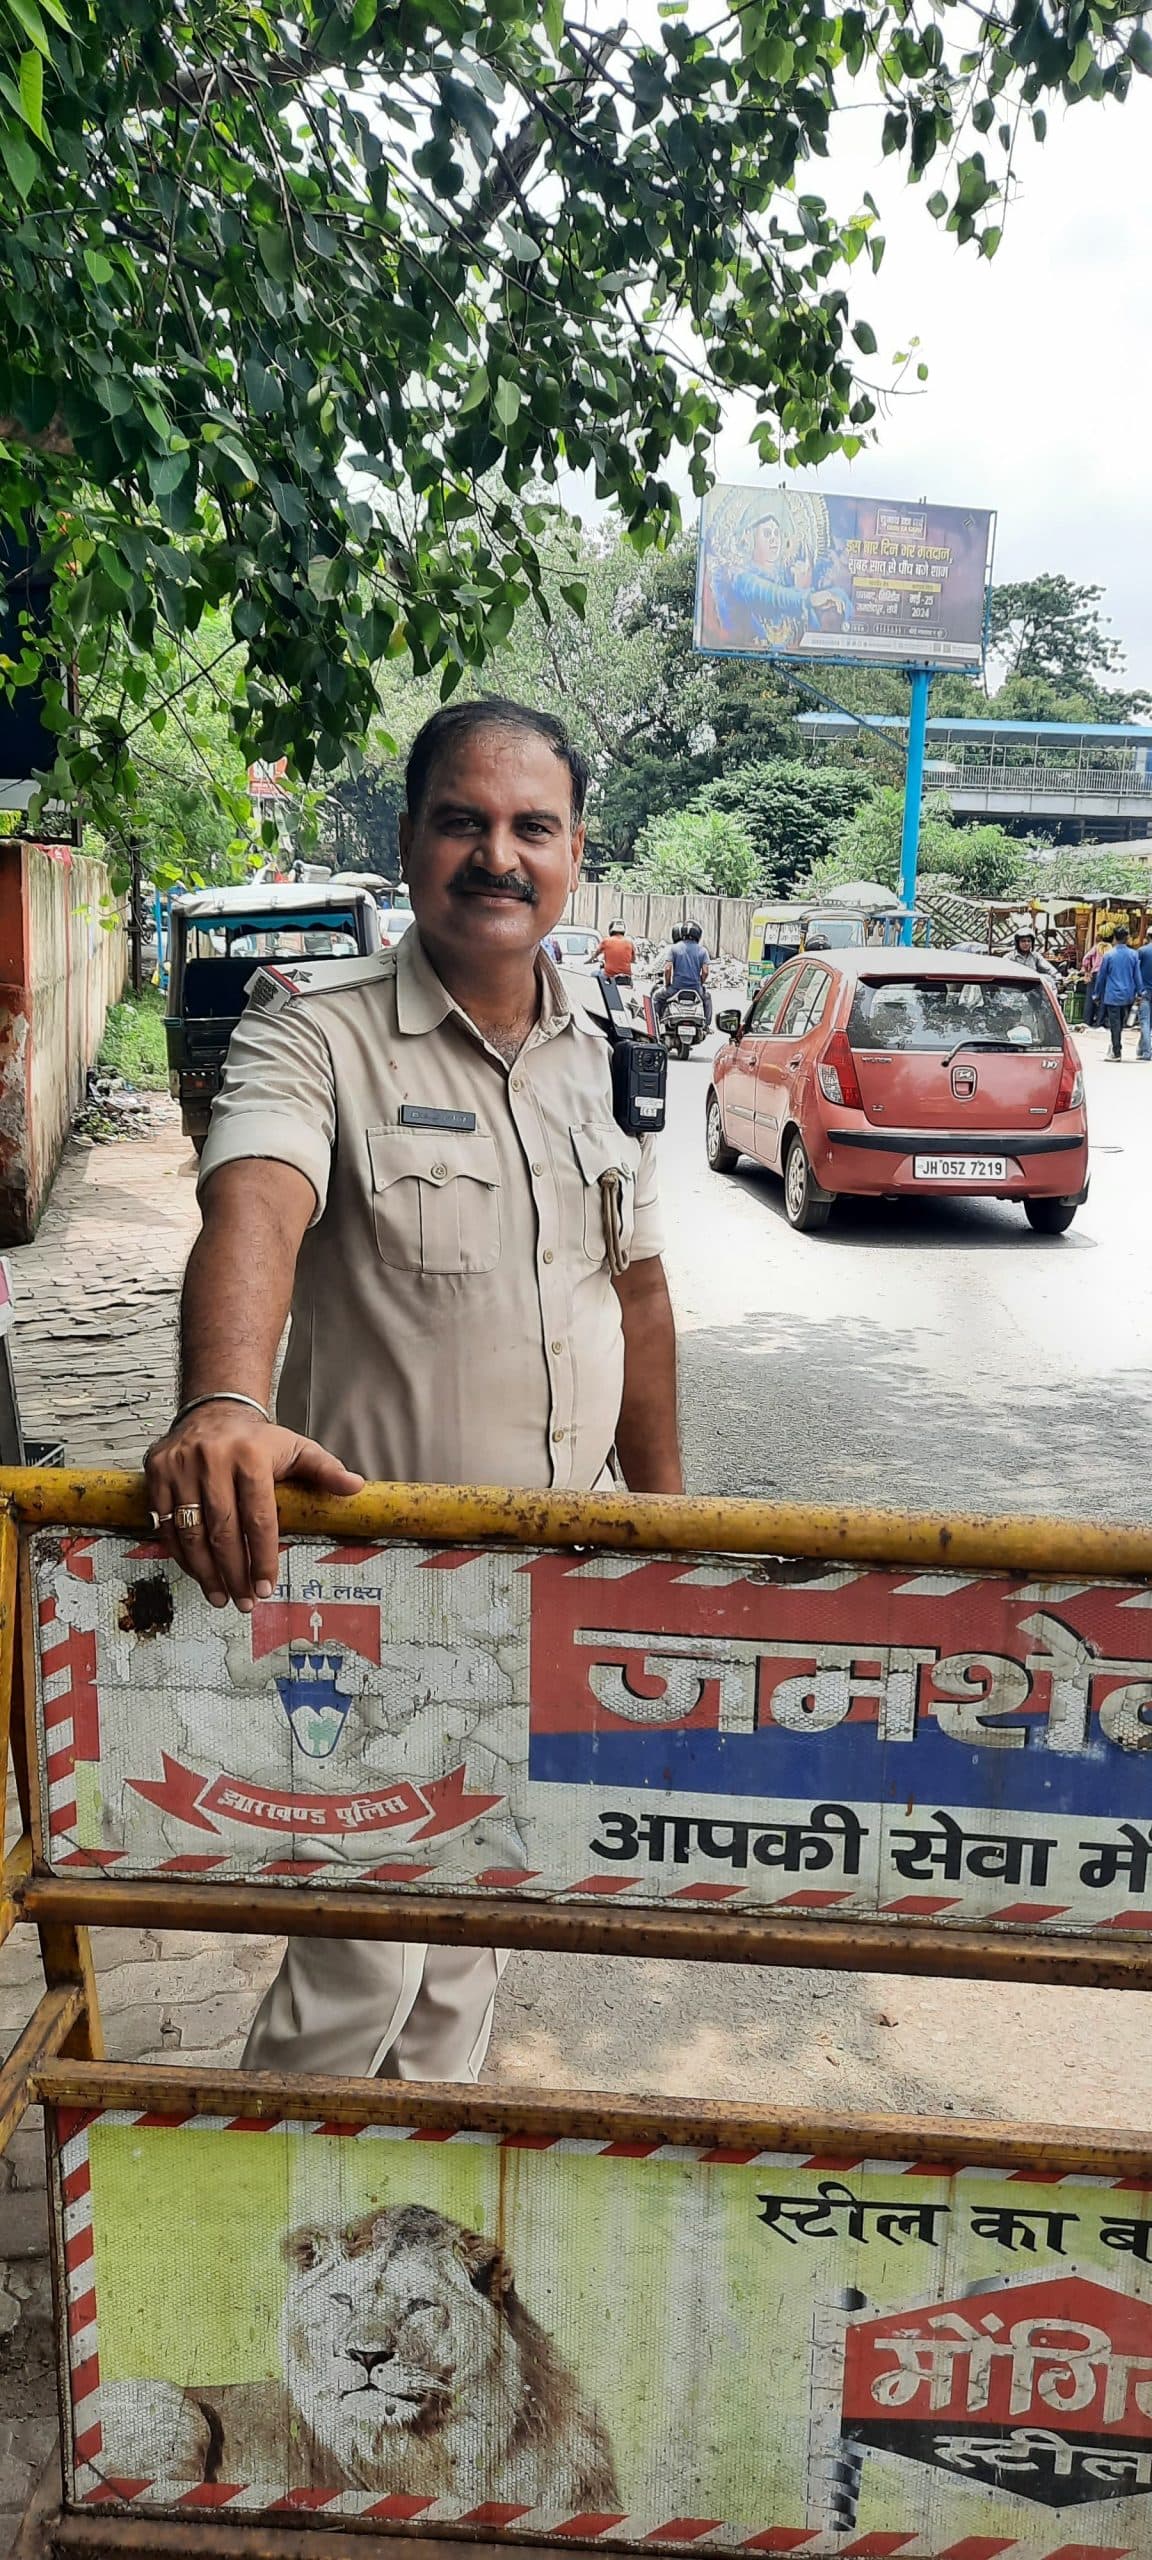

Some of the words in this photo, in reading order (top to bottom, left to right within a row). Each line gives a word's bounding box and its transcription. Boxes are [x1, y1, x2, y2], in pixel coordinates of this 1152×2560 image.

[864, 541, 879, 555] बार
[881, 539, 899, 557] दिन
[901, 543, 916, 558] भर
[848, 559, 868, 574] सुबह
[870, 559, 886, 577] सात
[888, 558, 897, 574] से
[915, 561, 929, 577] बजे
[930, 565, 949, 578] शाम
[911, 607, 930, 618] 2024
[923, 1161, 937, 1175] JH
[970, 1161, 1002, 1176] 7219
[301, 1579, 322, 1599] ही
[331, 1585, 382, 1600] लक्ष्य
[217, 1787, 326, 1825] झारखण्ड
[335, 1796, 409, 1828] पुलिस
[590, 1804, 868, 1875] आपकी
[890, 1811, 1057, 1888] सेवा
[756, 2181, 951, 2246] स्टील
[970, 2205, 1080, 2255] का
[870, 2312, 1152, 2425] मोंगि
[933, 2428, 1152, 2484] स्टील
